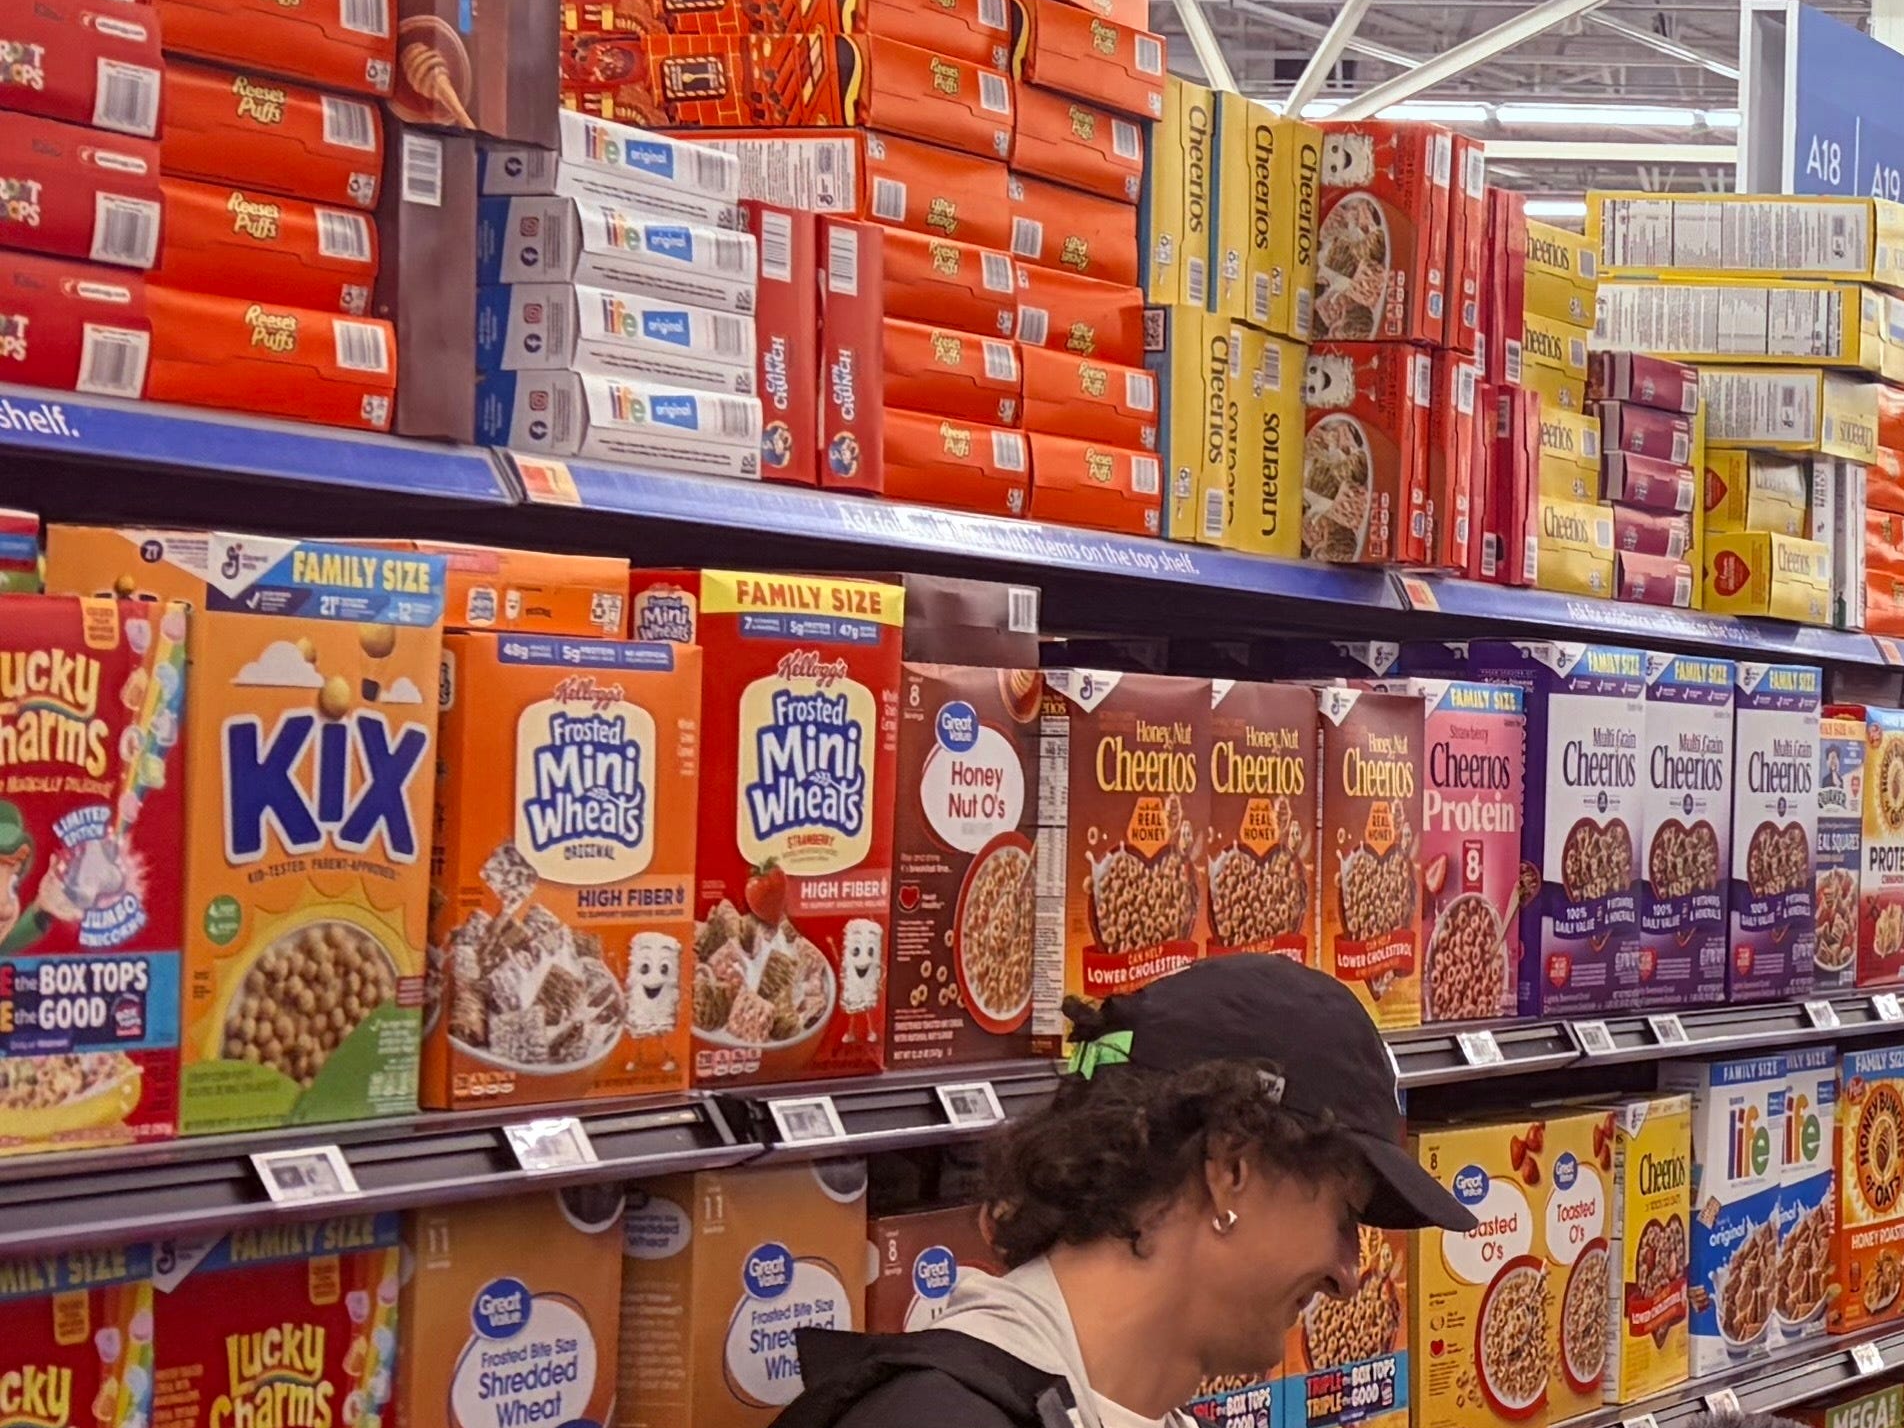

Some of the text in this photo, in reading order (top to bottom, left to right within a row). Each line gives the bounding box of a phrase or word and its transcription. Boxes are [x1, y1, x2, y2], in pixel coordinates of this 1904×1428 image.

[584, 115, 622, 166] life
[1188, 104, 1208, 233] Cheerios
[1806, 136, 1841, 186] A18
[1256, 124, 1275, 250] Cheerios
[1871, 169, 1900, 201] A19
[293, 551, 378, 590] FAMILY
[383, 560, 431, 594] SIZE
[1032, 536, 1200, 575] items on the top shelf.
[736, 580, 881, 614] FAMILY SIZE
[0, 648, 100, 721] ucky
[777, 649, 848, 688] Kellogg's
[554, 676, 624, 711] Kellogg's
[777, 694, 846, 726] Frosted
[1449, 687, 1516, 711] FAMILY SIZE
[553, 716, 623, 746] Frosted
[939, 712, 974, 732] Great
[1135, 720, 1192, 748] Honey Nut
[1449, 724, 1489, 745] Strawberry
[0, 710, 109, 777] harms
[762, 725, 859, 784] Mini
[538, 745, 638, 800] Mini
[951, 764, 1004, 789] Honey
[1097, 735, 1197, 794] Cheerios
[1210, 740, 1305, 796] Cheerios
[1342, 748, 1414, 799] Cheerios
[1429, 741, 1510, 790] Cheerios
[1563, 740, 1636, 787] Cheerios
[1650, 745, 1723, 791] Cheerios
[222, 708, 429, 868] KIX
[751, 774, 862, 832] Wheats
[528, 785, 643, 848] Wheats
[948, 795, 1006, 819] Nut O's
[1137, 809, 1163, 826] REAL
[1422, 790, 1516, 833] Protein
[1130, 826, 1168, 841] HONEY
[1465, 854, 1480, 877] 8
[578, 889, 674, 907] HIGH FIBER
[802, 881, 880, 898] HIGH FIBER
[38, 961, 148, 995] BOX TOPS
[37, 999, 106, 1031] GOOD
[1723, 1060, 1778, 1081] FAMILY SIZE
[1728, 1105, 1770, 1181] life
[1639, 1152, 1685, 1196] Cheerios
[1556, 1200, 1596, 1227] Toasted
[1709, 1215, 1747, 1247] original
[1568, 1220, 1585, 1244] O's
[1851, 1229, 1879, 1250] HONEY
[478, 1292, 526, 1322] Great
[225, 1322, 326, 1379] Lucky
[480, 1337, 579, 1369] Frosted Bite Size
[477, 1358, 579, 1398] Shredded
[496, 1395, 563, 1428] Wheat
